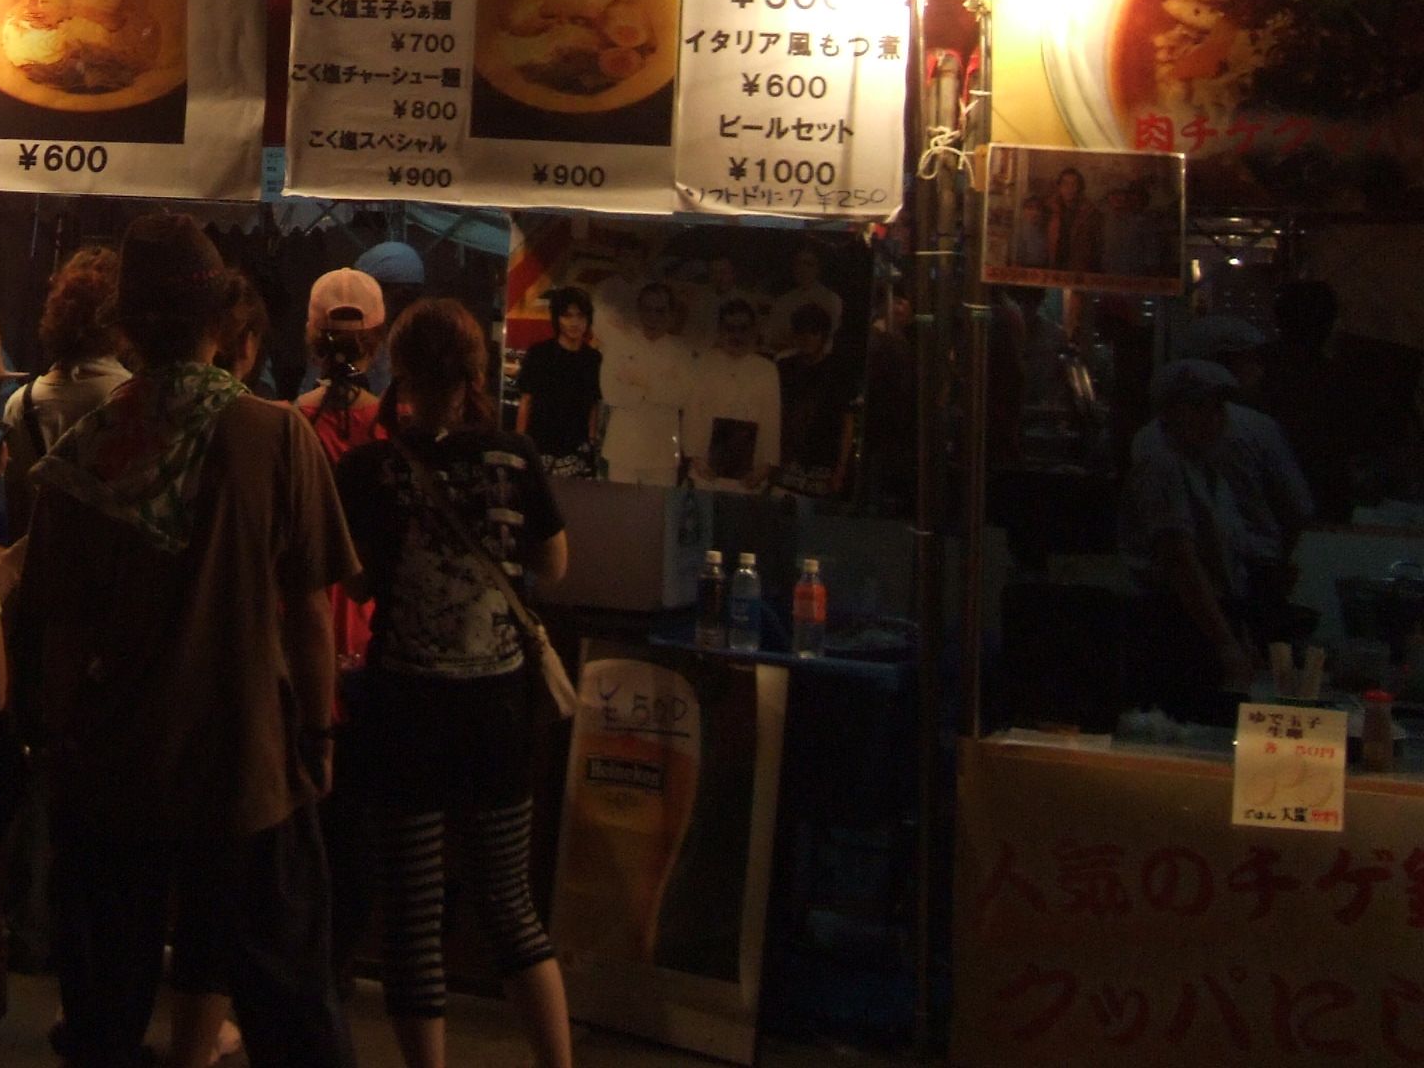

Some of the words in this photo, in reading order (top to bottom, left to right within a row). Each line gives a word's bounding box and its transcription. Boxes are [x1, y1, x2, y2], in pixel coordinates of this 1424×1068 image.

[391, 33, 455, 53] ¥700
[685, 30, 901, 60] イタリア風もつ煮
[742, 73, 827, 99] ¥600
[393, 100, 456, 120] ¥800
[719, 114, 855, 144] ビールセット
[308, 130, 447, 154] こく塩スペシャル
[18, 144, 108, 172] ¥600
[388, 166, 452, 188] ¥900
[533, 163, 605, 188] ¥900
[729, 157, 836, 185] ¥1000
[814, 187, 887, 208] ¥250
